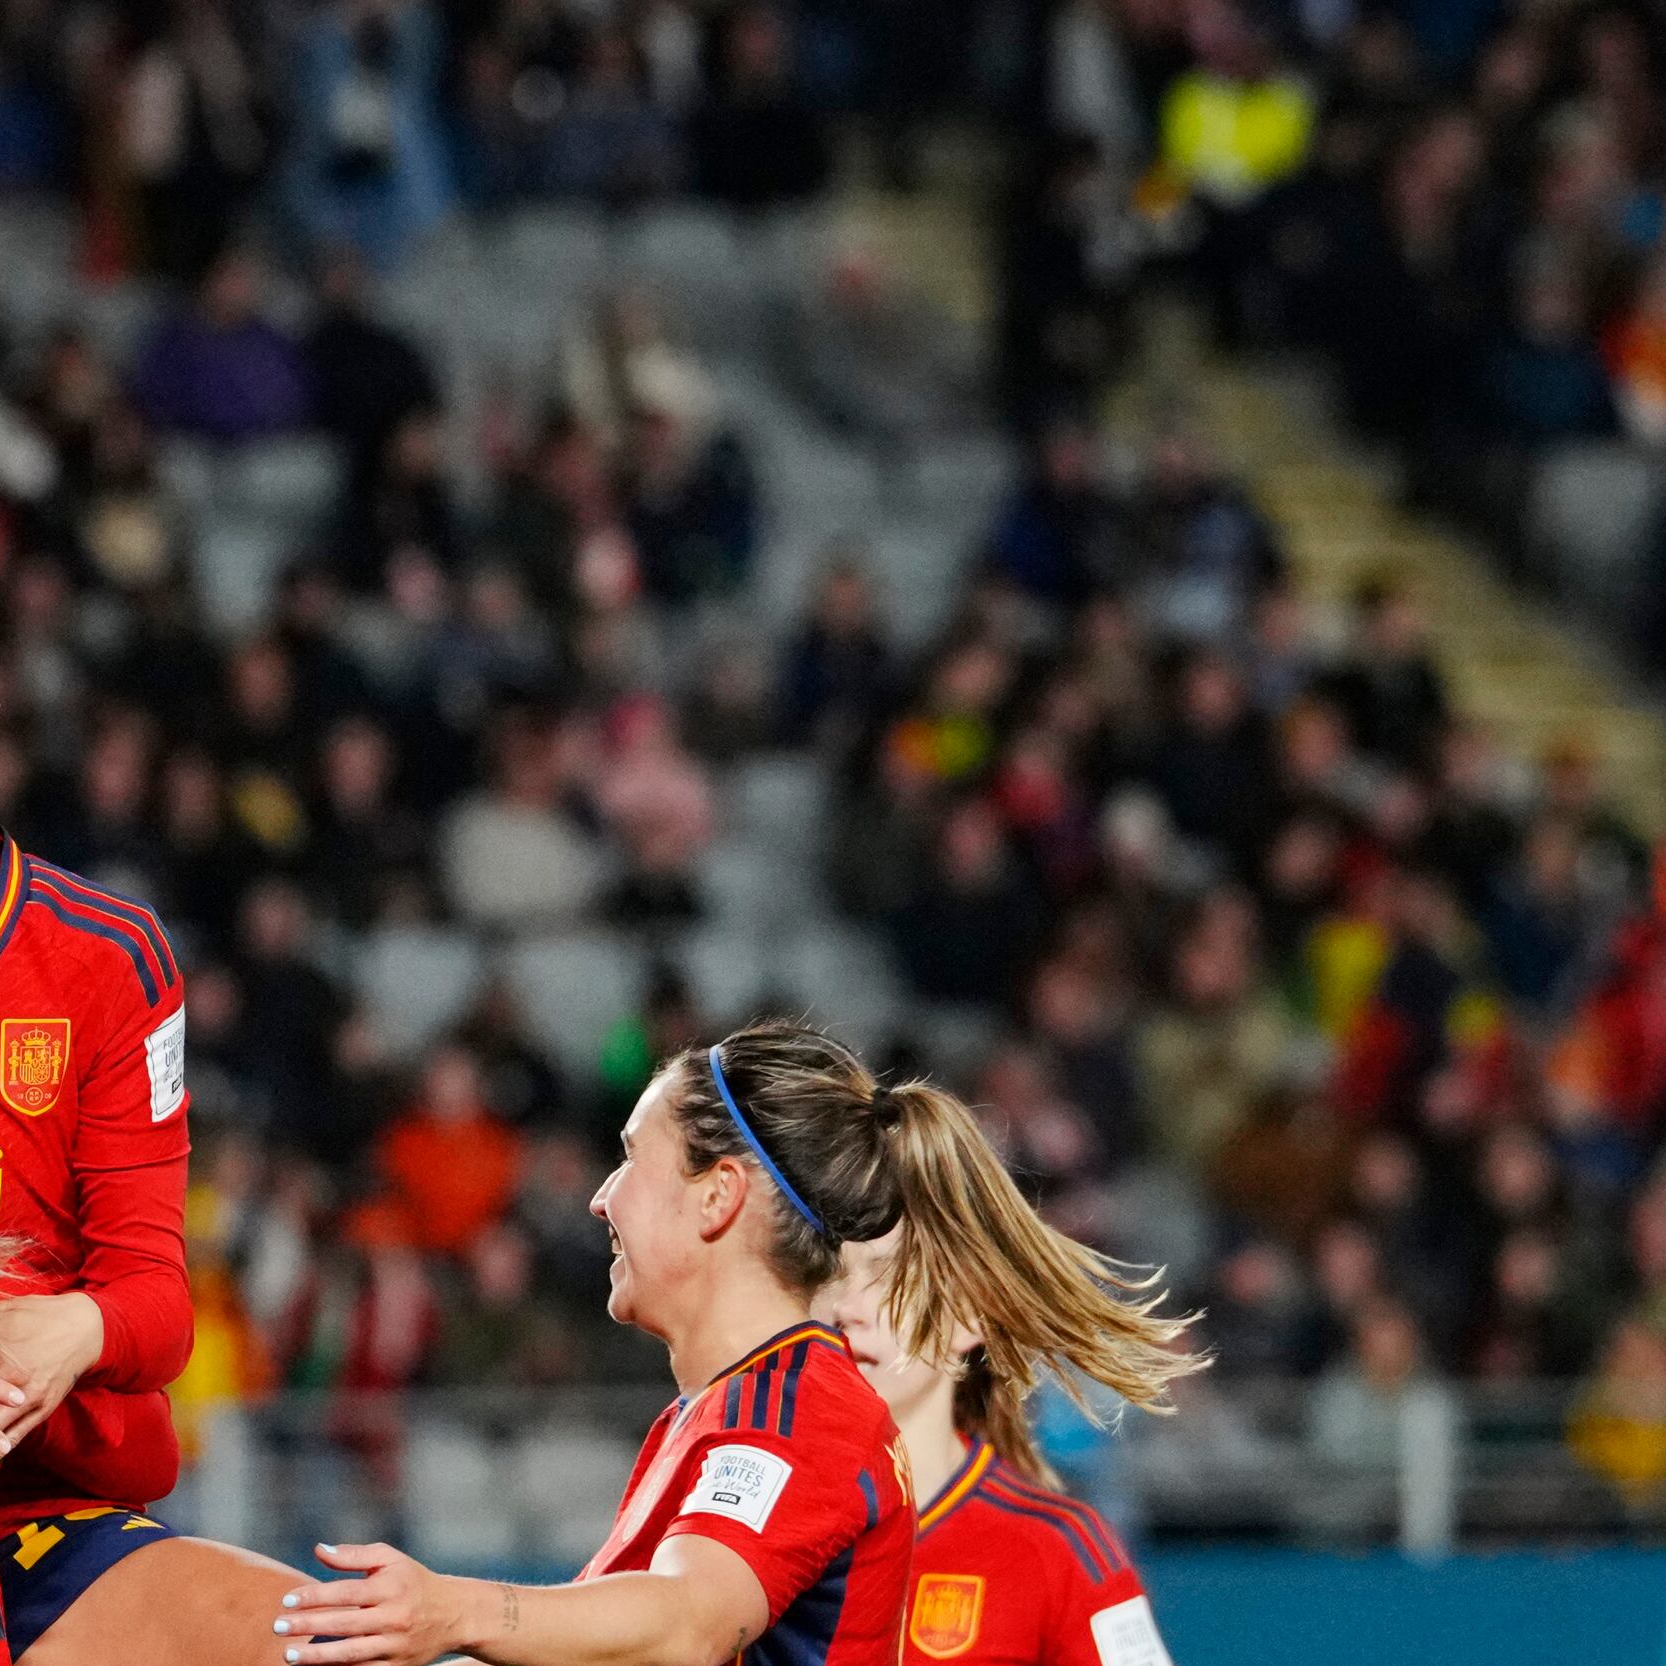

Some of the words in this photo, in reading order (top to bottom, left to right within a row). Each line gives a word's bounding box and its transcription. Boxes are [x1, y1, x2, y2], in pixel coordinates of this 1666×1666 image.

[714, 1464, 764, 1487] UNITES
[719, 1455, 767, 1476] FOOTBALL
[714, 1492, 739, 1504] FIFA
